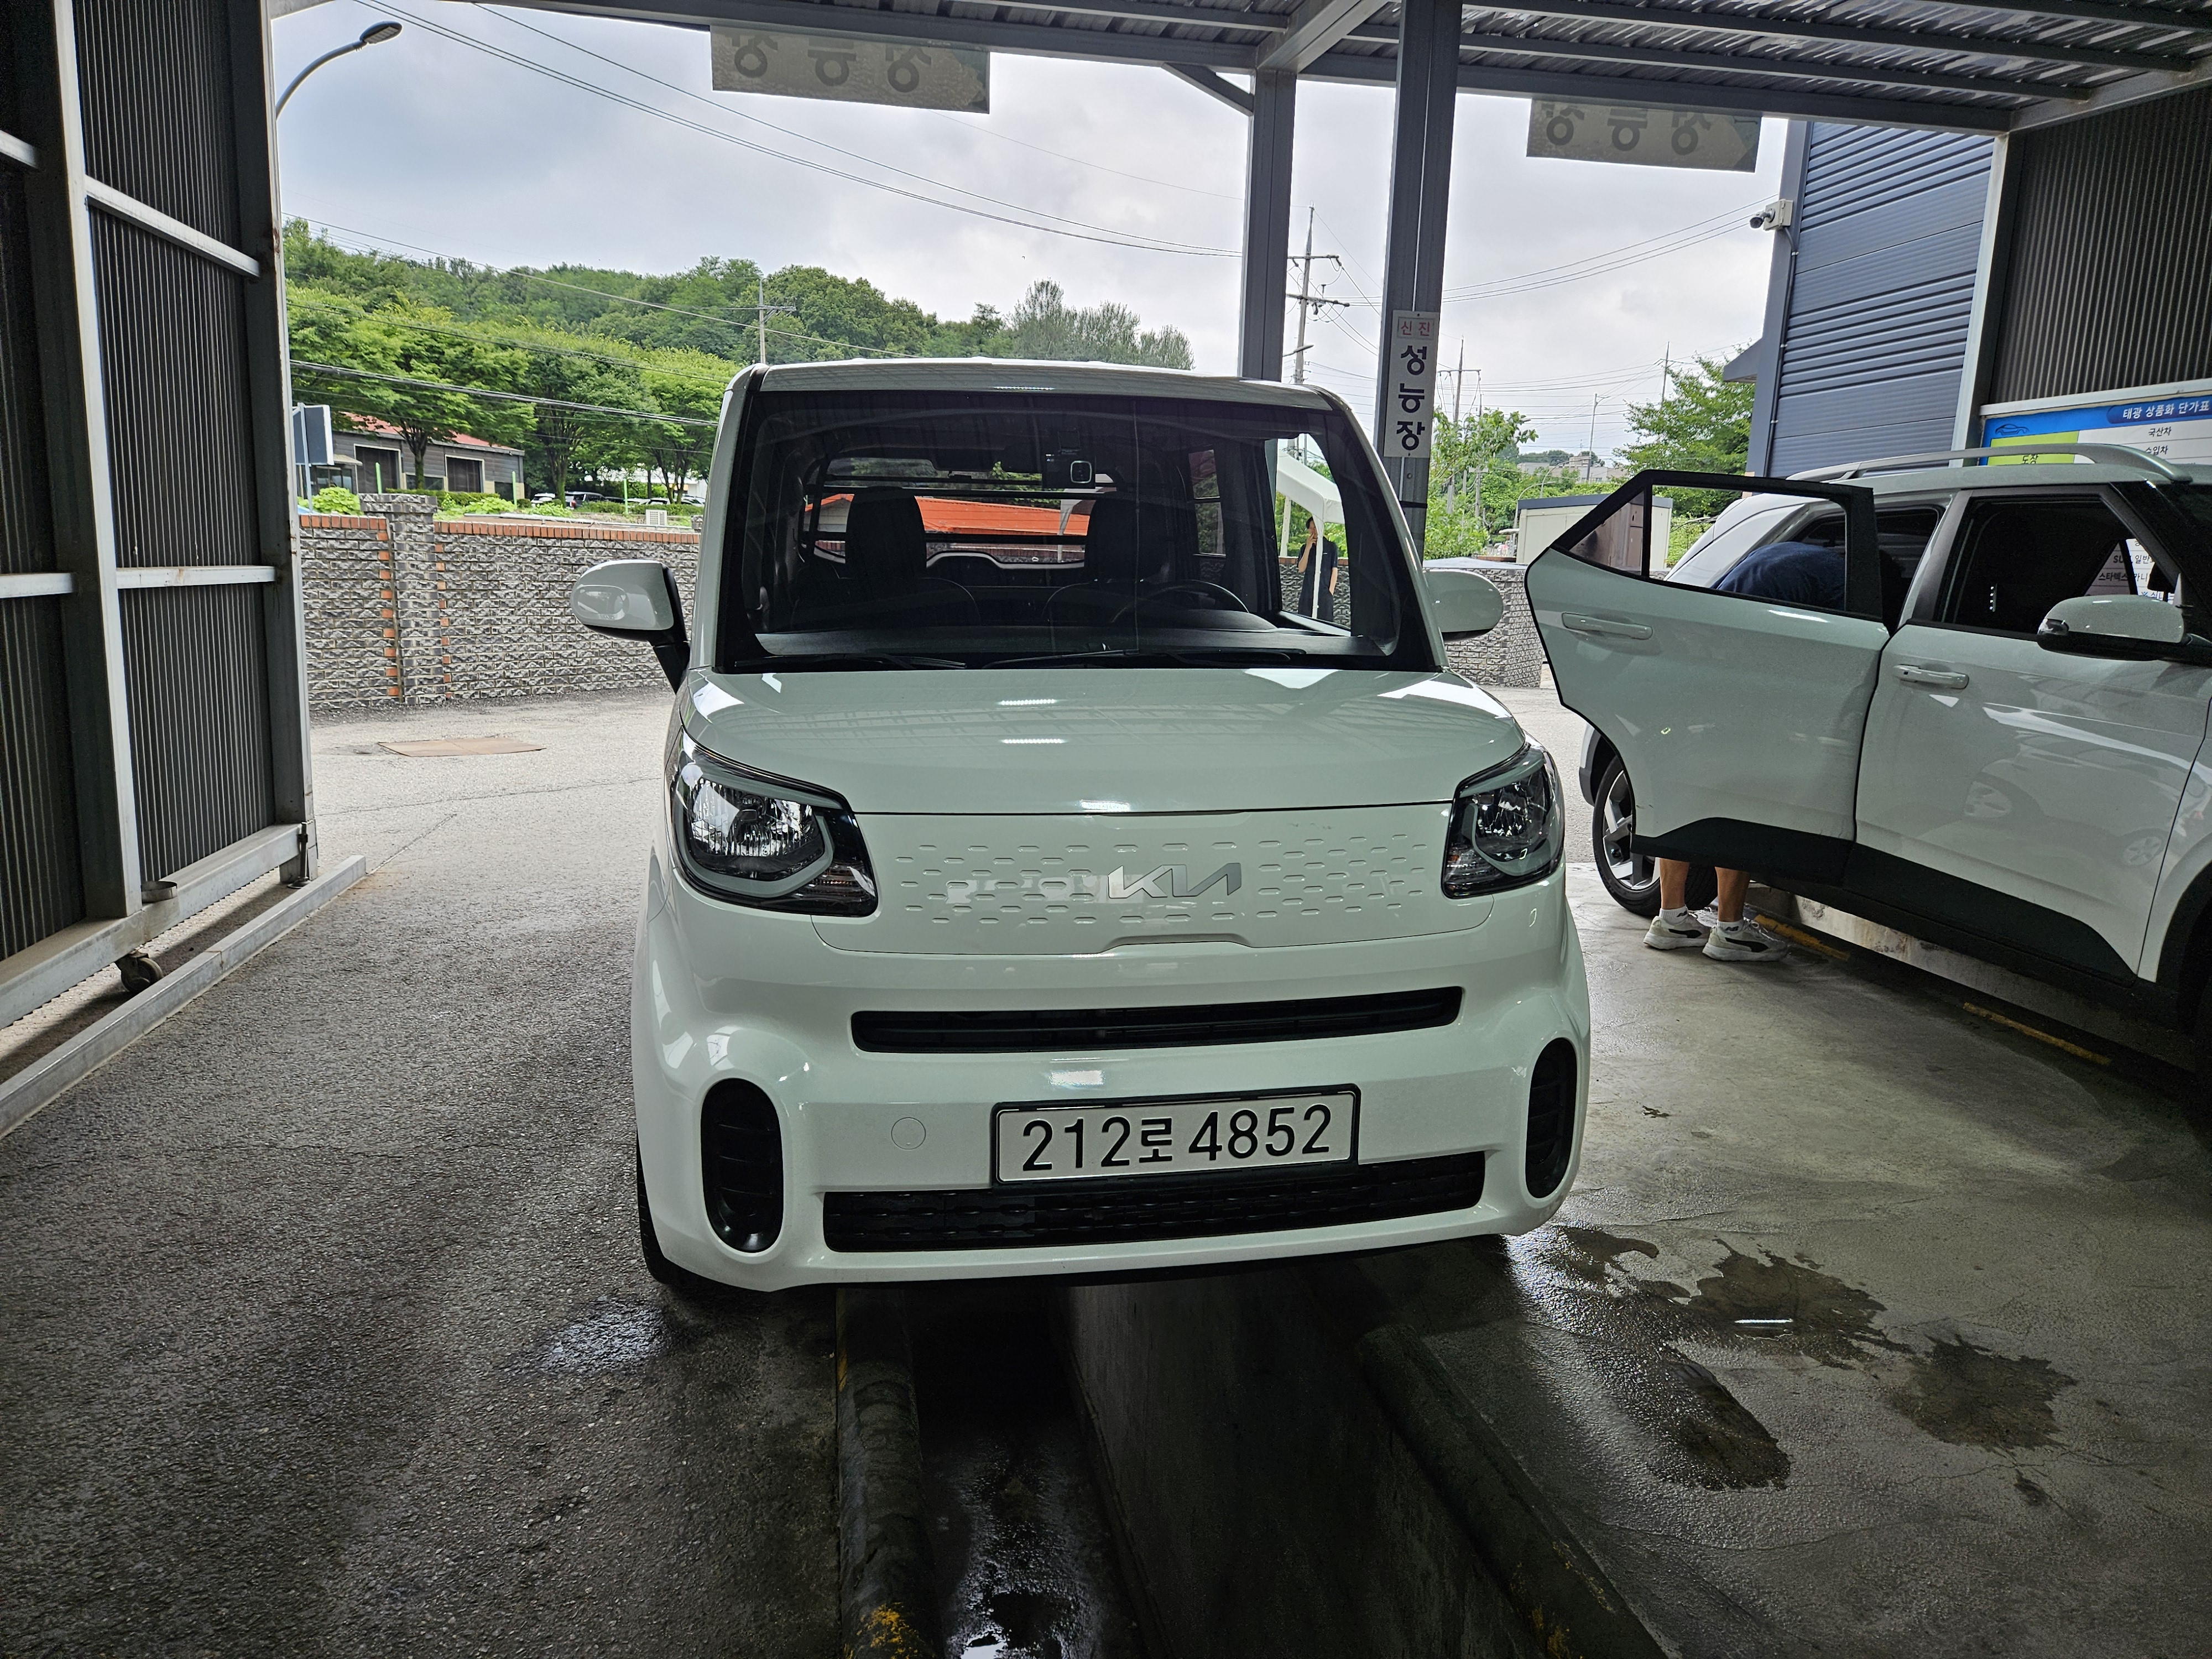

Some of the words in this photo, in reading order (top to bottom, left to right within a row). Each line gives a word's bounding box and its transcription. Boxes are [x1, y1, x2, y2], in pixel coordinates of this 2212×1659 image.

[1400, 320, 1430, 337] 신진
[1396, 345, 1428, 451] 성능장
[2122, 406, 2143, 419] 태광
[2145, 403, 2175, 418] 상품화
[2178, 400, 2210, 414] 단가표
[2148, 426, 2172, 437] 국산차
[1108, 862, 1242, 899] KIA
[1022, 1116, 1173, 1171] 212로
[1188, 1104, 1332, 1161] 4852
